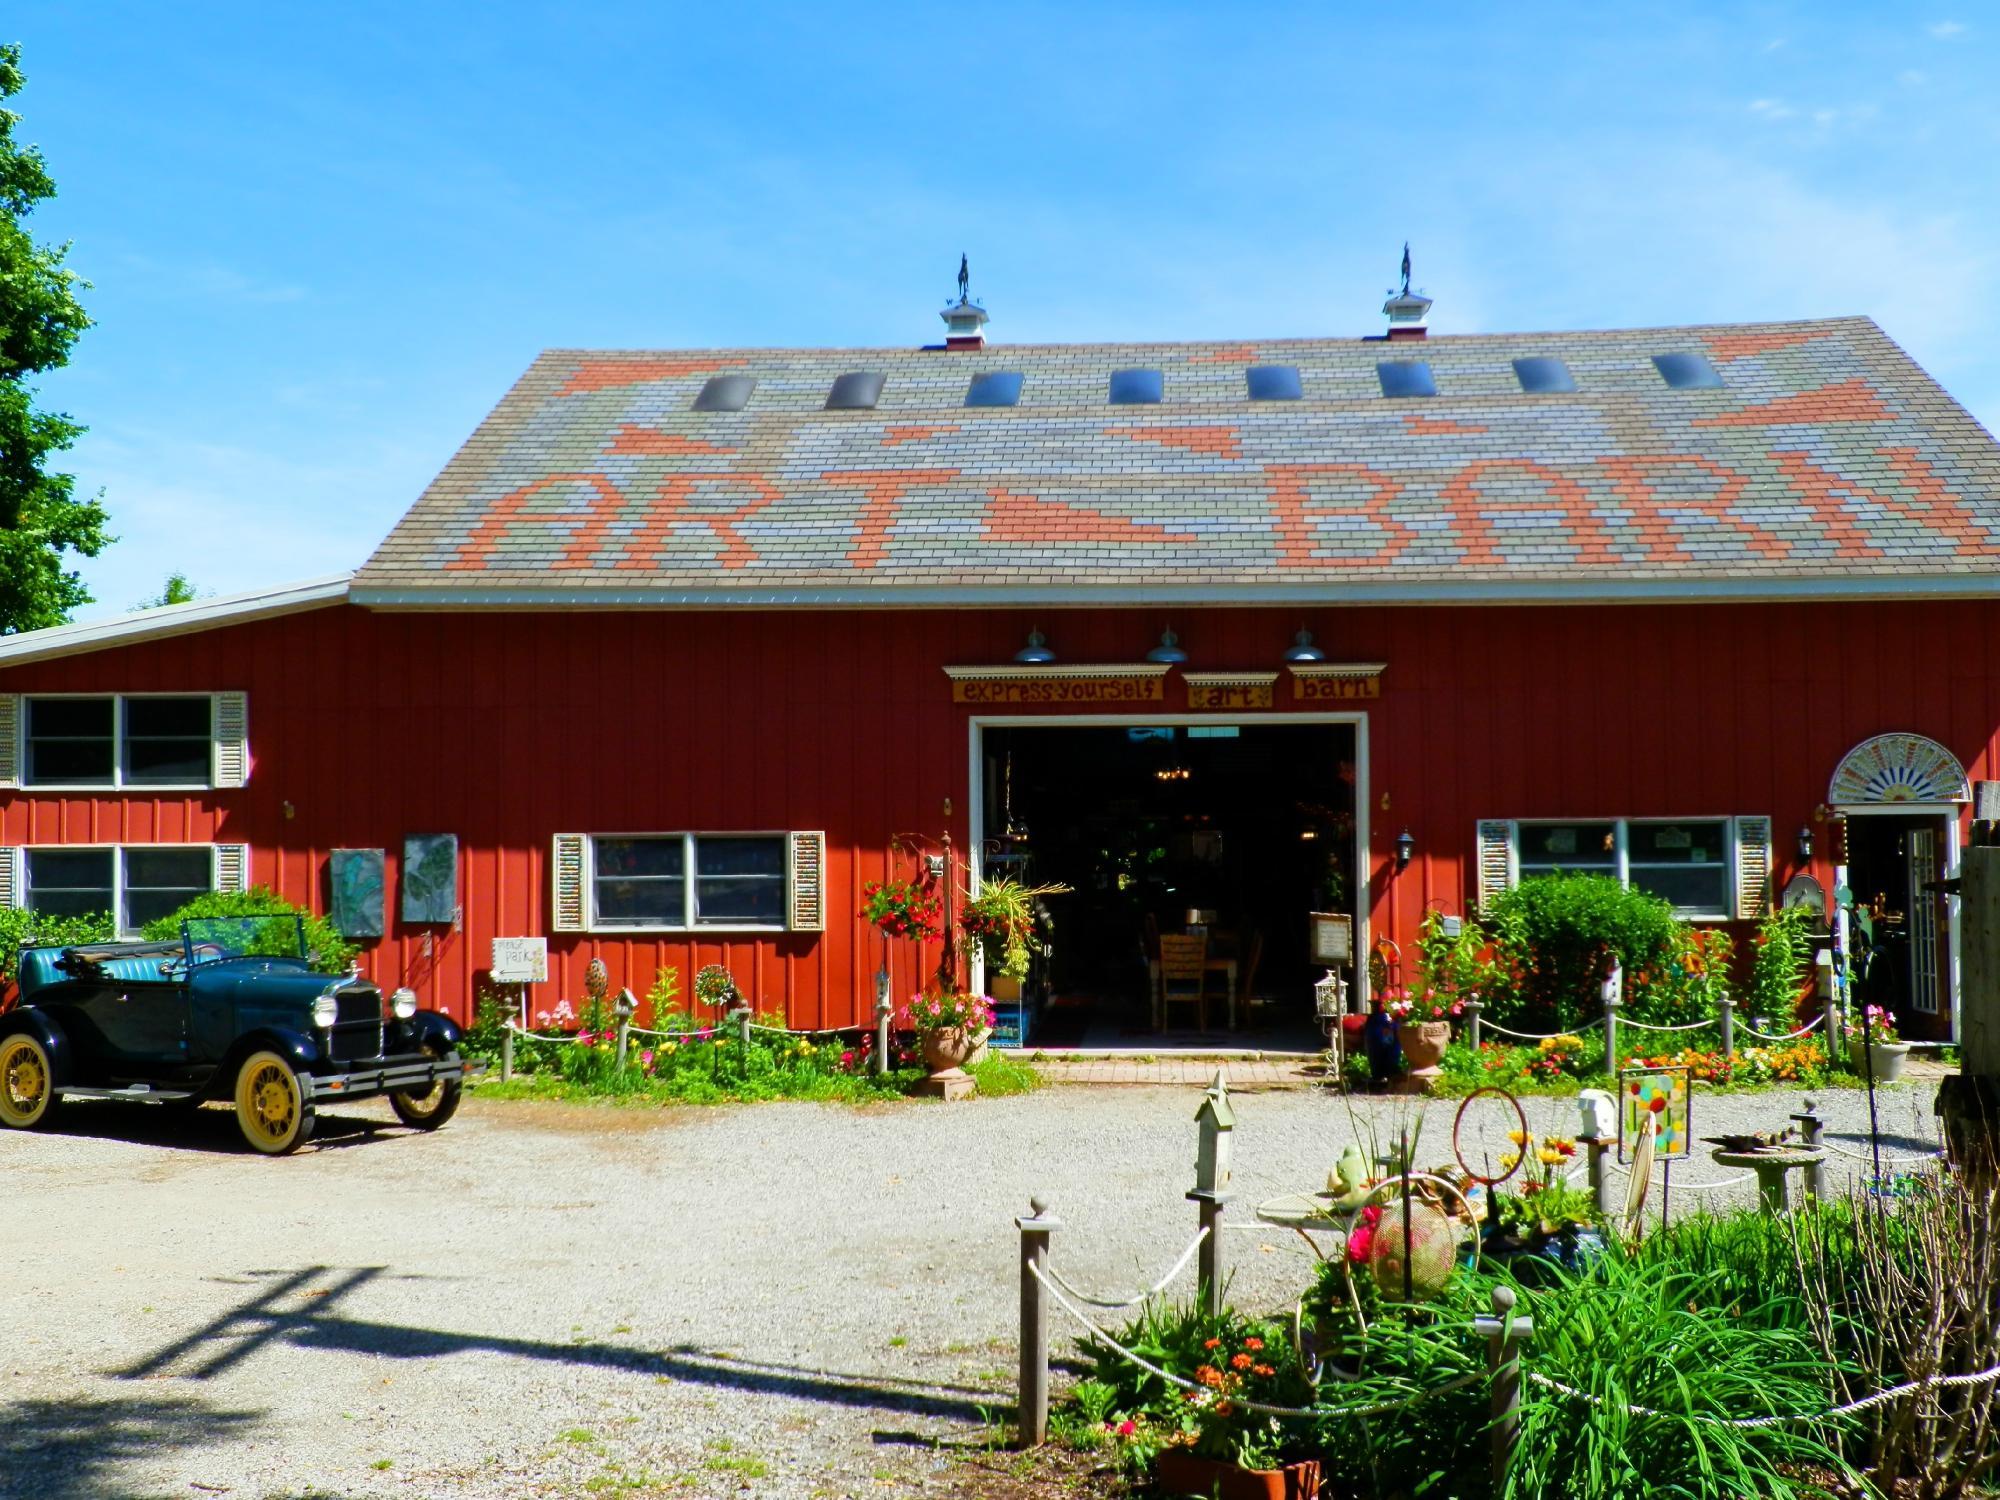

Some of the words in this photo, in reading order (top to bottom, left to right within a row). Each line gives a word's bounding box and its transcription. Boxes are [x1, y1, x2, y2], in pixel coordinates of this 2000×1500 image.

[963, 680, 1054, 701] express
[1205, 686, 1255, 707] art
[1301, 677, 1372, 698] barn
